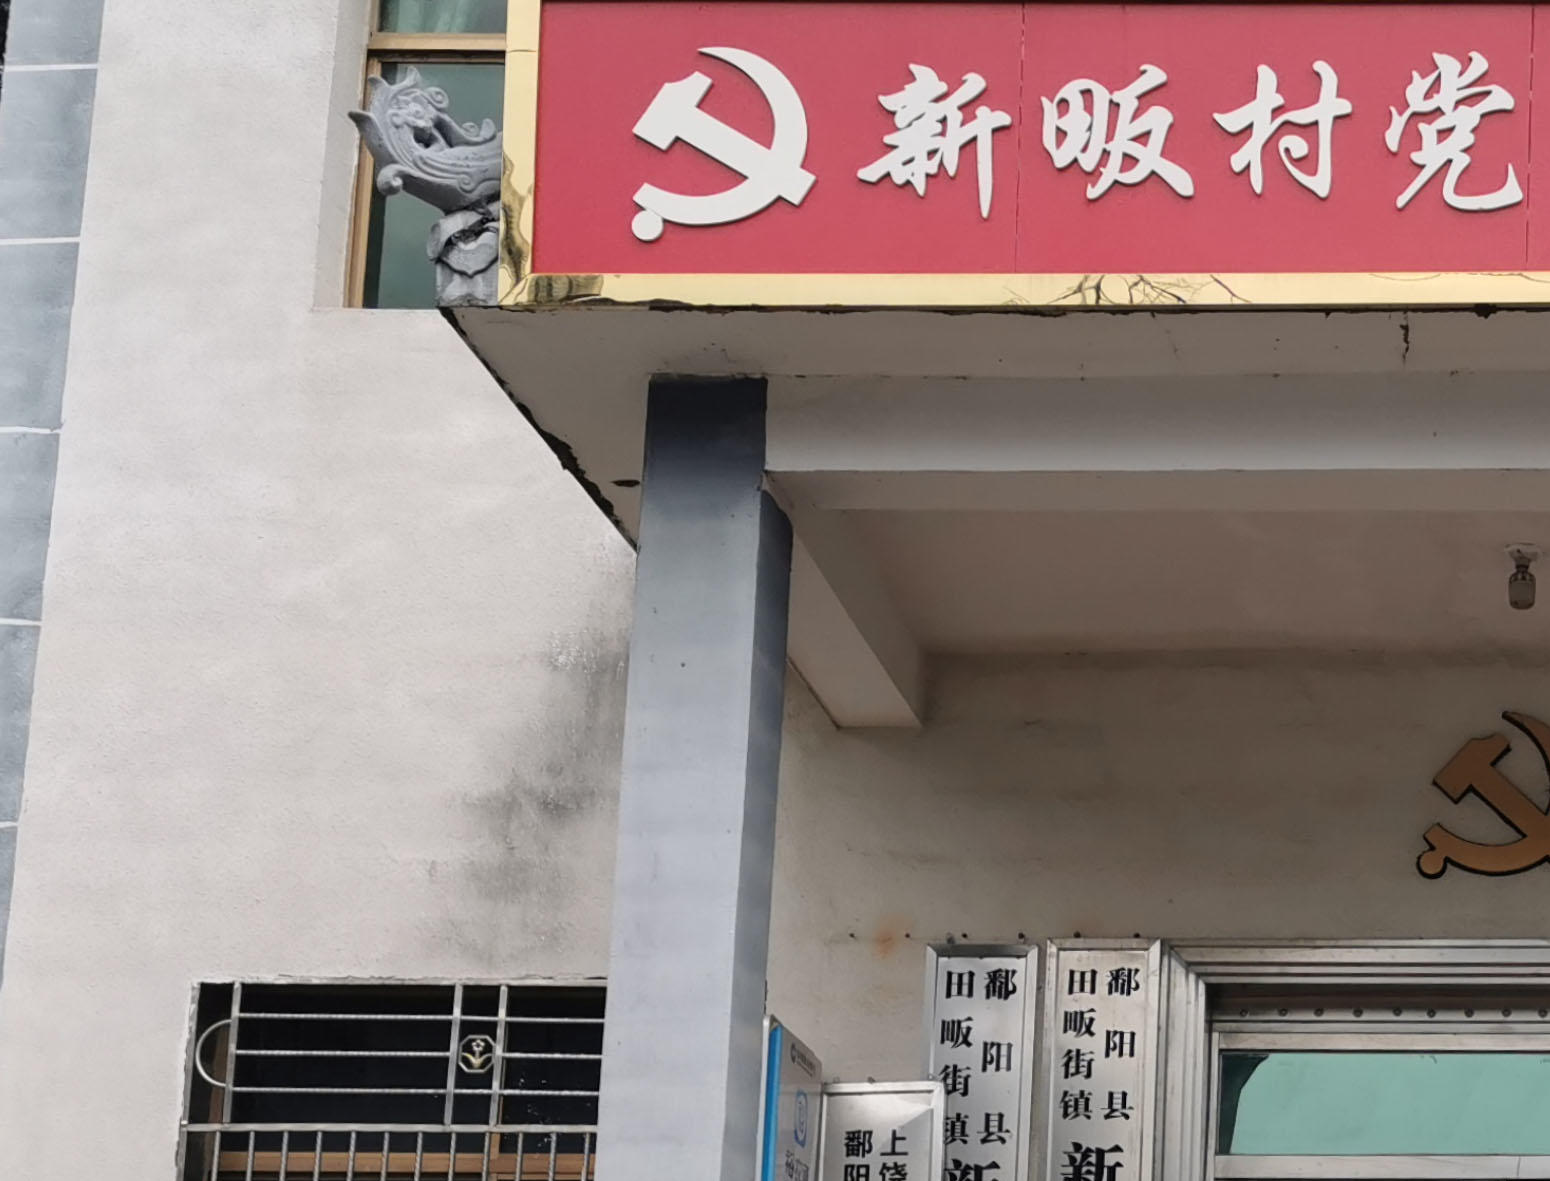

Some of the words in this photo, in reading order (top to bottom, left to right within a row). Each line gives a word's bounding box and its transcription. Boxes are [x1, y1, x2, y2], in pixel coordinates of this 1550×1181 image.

[938, 970, 976, 1145] 田畈街镇
[976, 968, 1018, 1145] 鄱阳县
[1059, 967, 1098, 1122] 田畈街镇
[1100, 966, 1141, 1122] 鄱阳县
